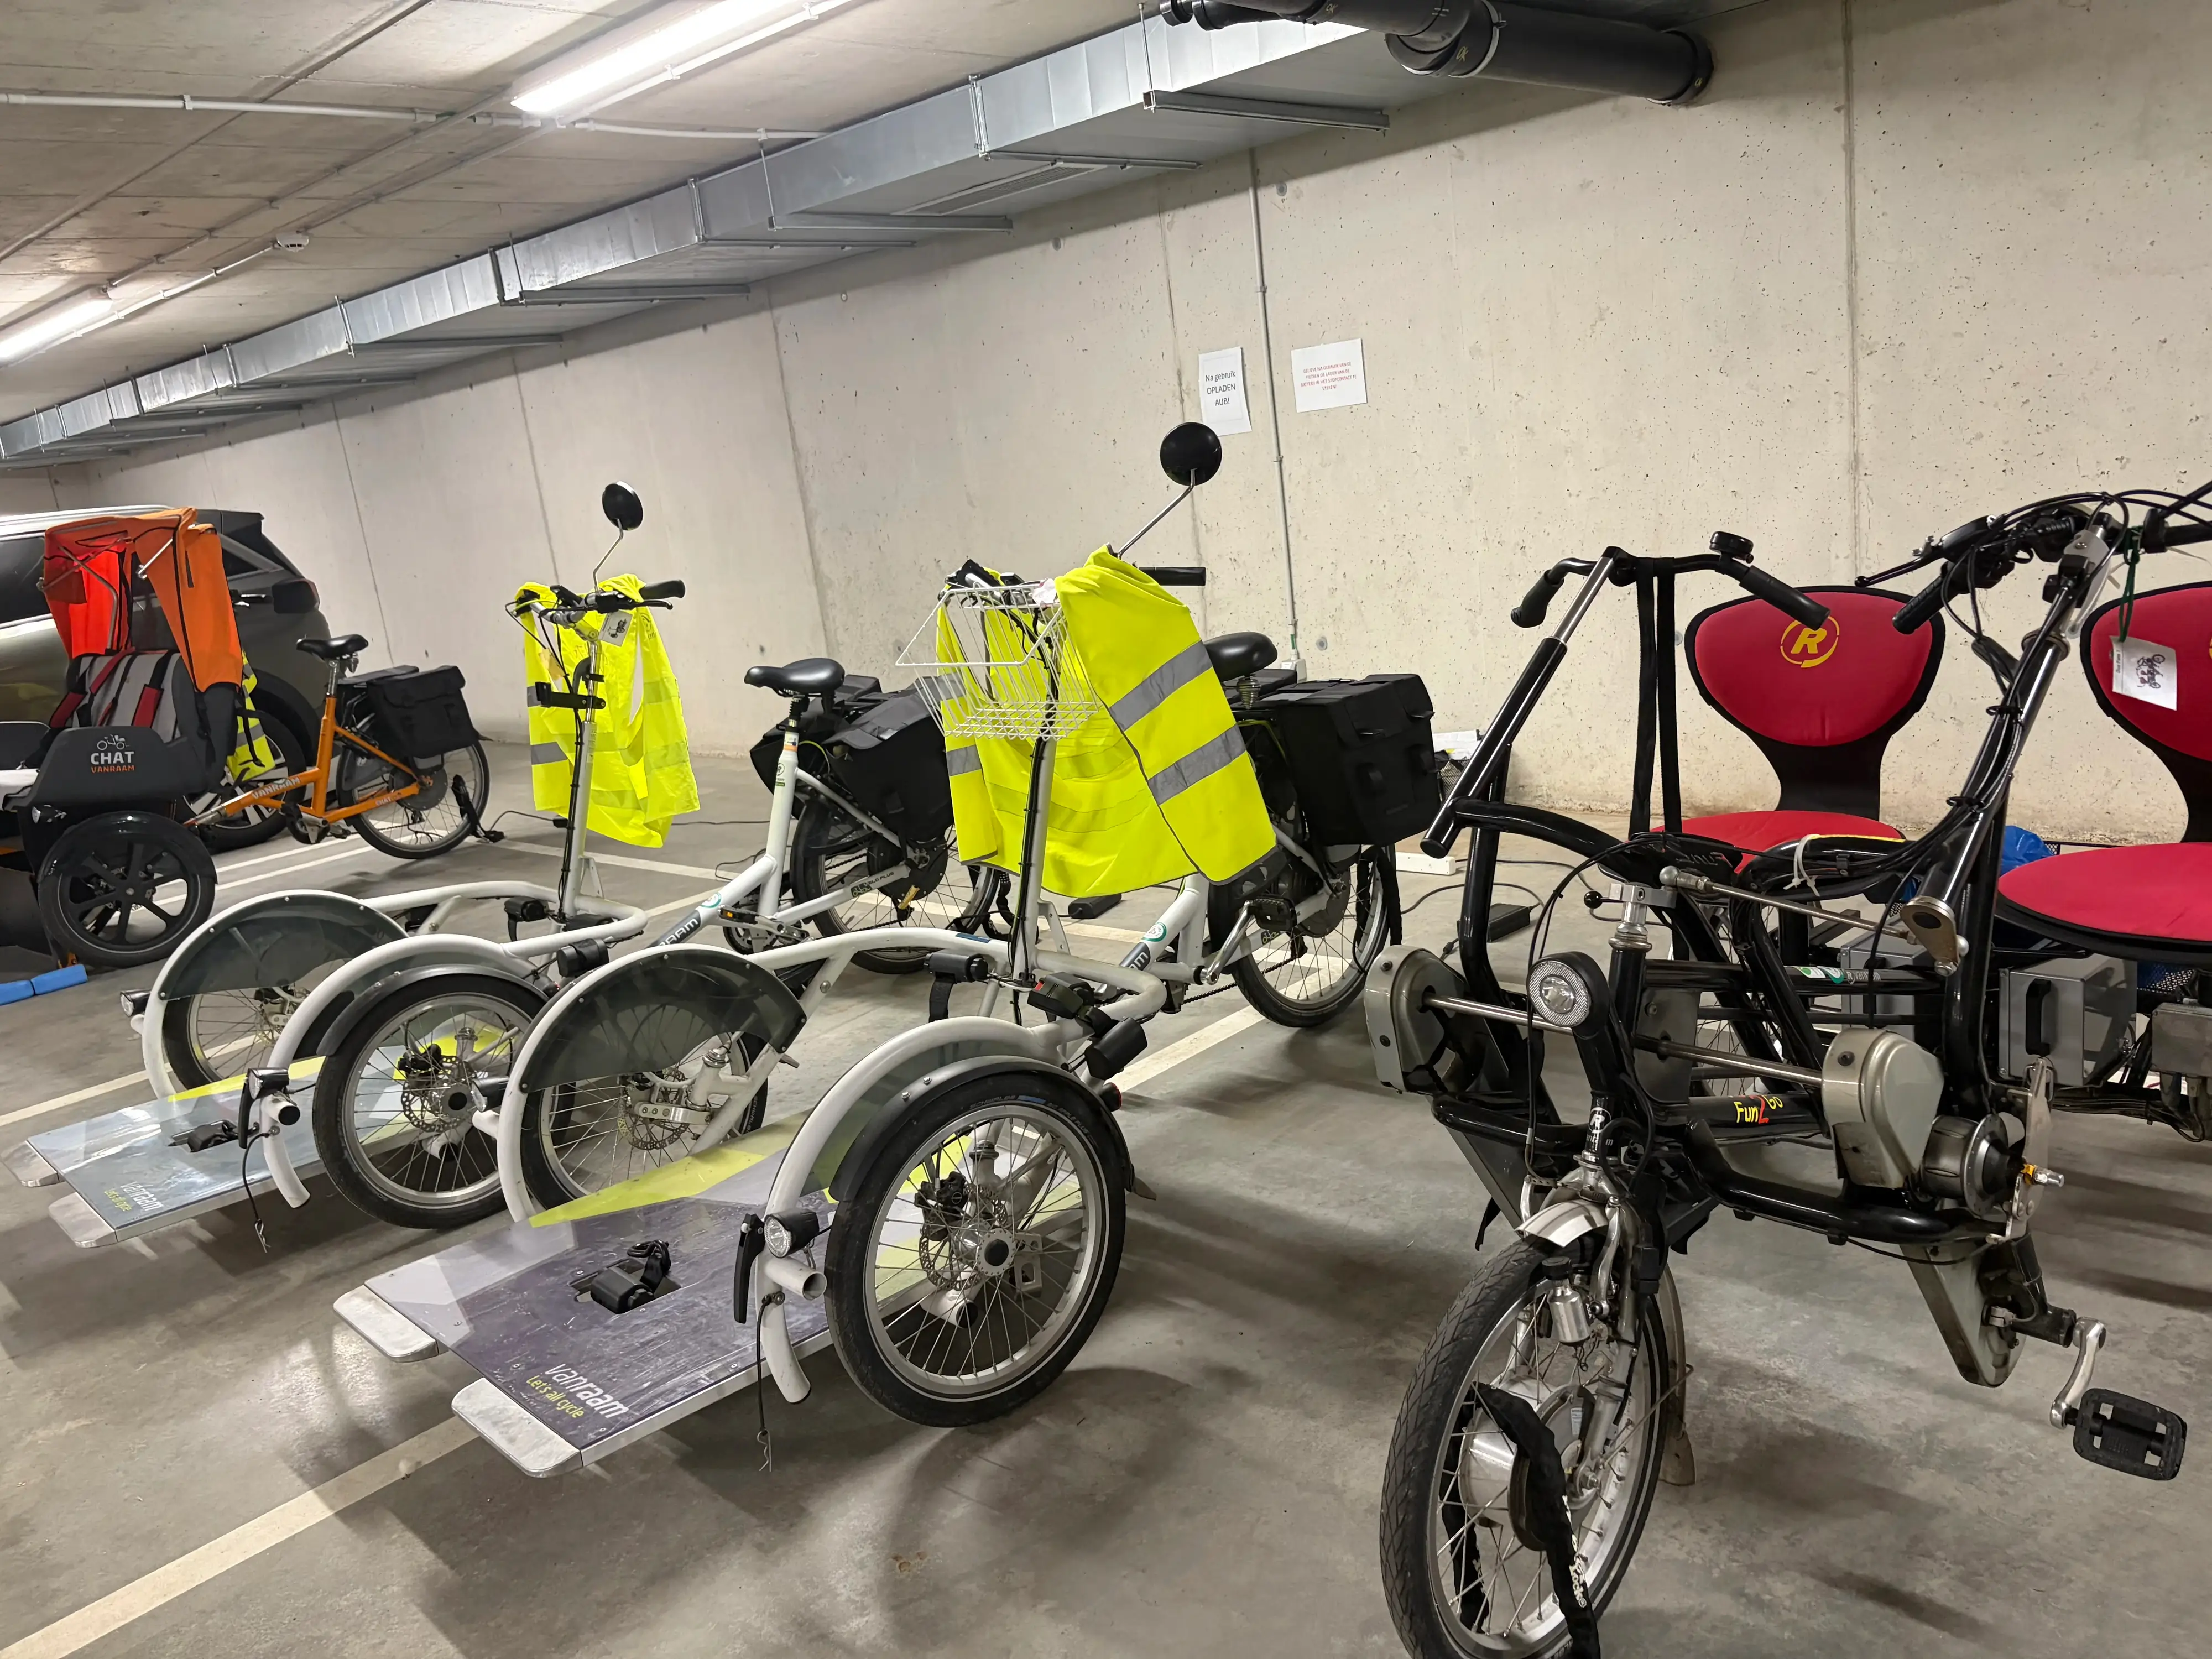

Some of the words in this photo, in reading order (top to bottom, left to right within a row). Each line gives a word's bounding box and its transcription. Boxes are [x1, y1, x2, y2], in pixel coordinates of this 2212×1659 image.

[1214, 371, 1236, 382] gebruik
[1328, 375, 1352, 383] STOPCONTACT
[1207, 383, 1236, 394] OPLADEN
[1215, 397, 1230, 406] AUB!
[91, 752, 134, 765] CHAT
[91, 765, 134, 773] VANRAAM
[863, 878, 879, 886] VELO
[880, 871, 894, 880] PLUS
[120, 1181, 164, 1211] vanraam
[526, 1375, 551, 1394] Let's
[545, 1391, 566, 1402] all
[556, 1399, 585, 1418] cycle
[545, 1364, 629, 1418] vanraam
